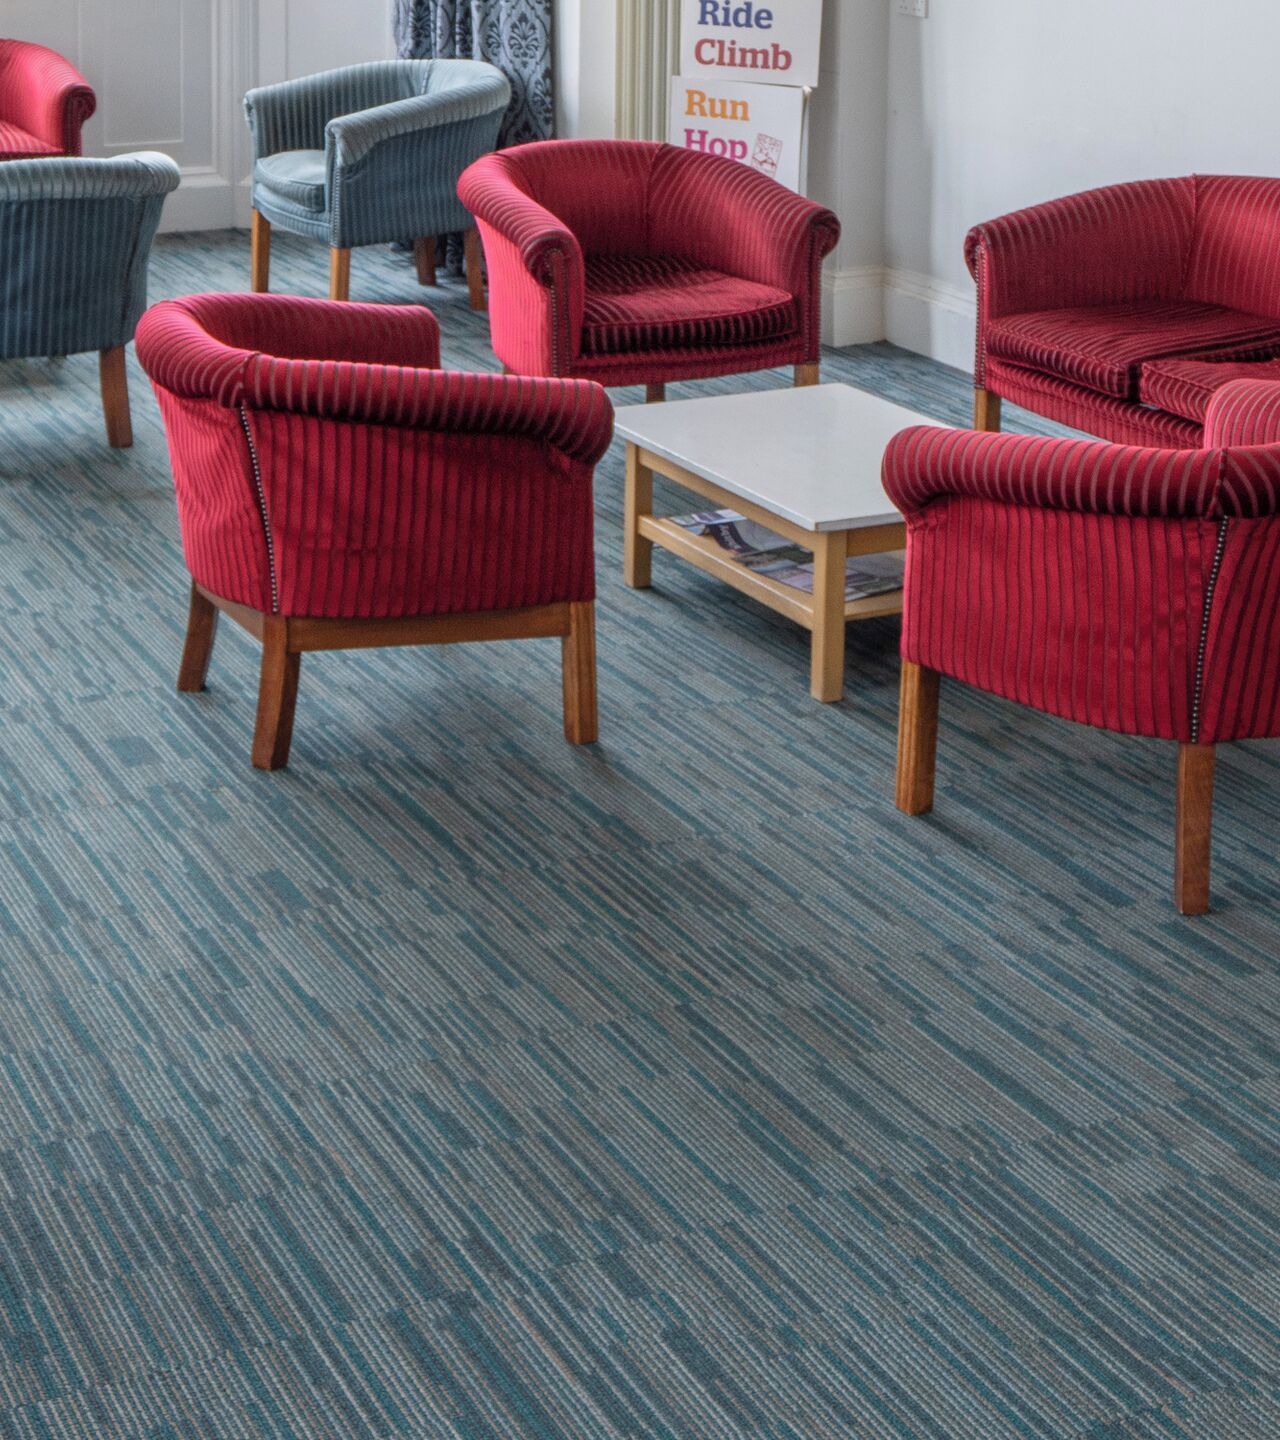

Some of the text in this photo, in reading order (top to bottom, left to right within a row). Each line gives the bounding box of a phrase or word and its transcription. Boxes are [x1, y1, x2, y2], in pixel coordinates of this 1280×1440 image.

[694, 38, 793, 71] Climb
[685, 89, 750, 121] Run
[683, 128, 748, 161] Hop
